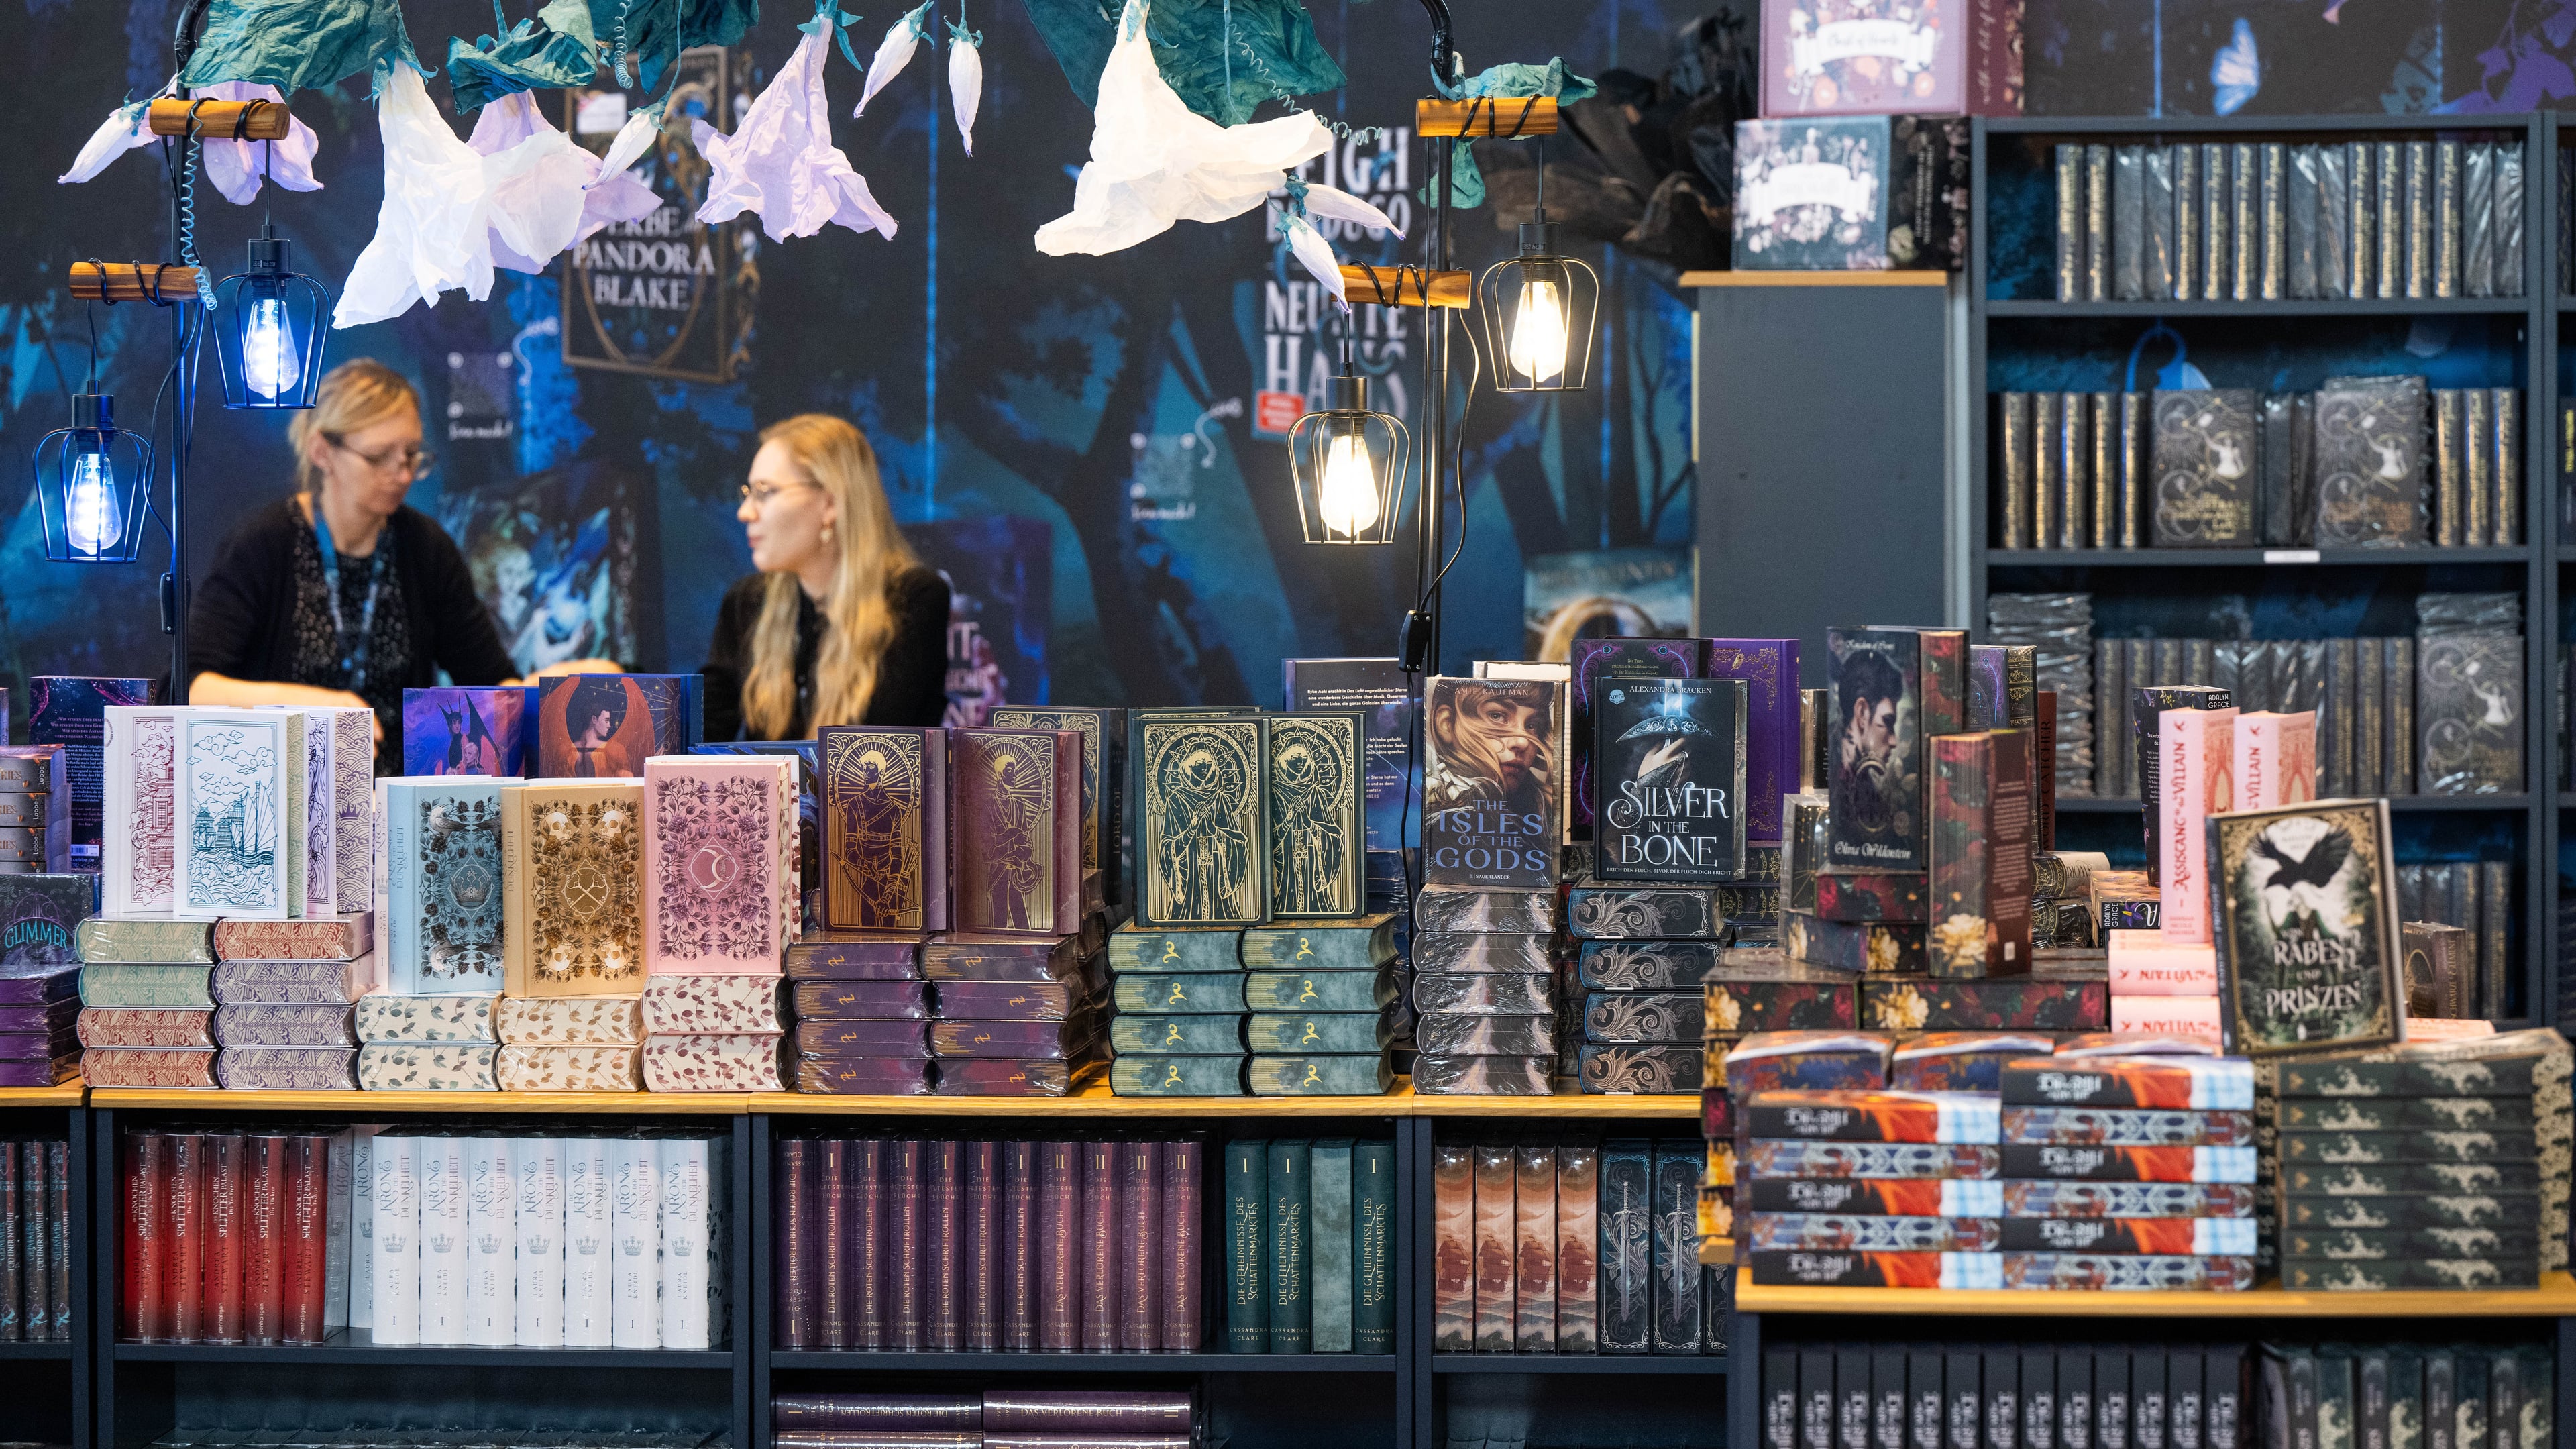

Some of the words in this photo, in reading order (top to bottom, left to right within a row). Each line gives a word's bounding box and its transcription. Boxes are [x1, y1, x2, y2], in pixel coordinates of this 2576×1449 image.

[1268, 127, 1409, 196] IGH
[572, 239, 715, 276] PANDORA
[594, 274, 690, 309] BLAKE
[2208, 694, 2229, 702] ADALYN
[2208, 700, 2230, 709] GRACE
[2041, 720, 2051, 794] CATCHER
[1472, 800, 1509, 812] THE
[1608, 780, 1729, 829] SILVER
[1440, 811, 1543, 836] ISLES
[1648, 820, 1661, 833] IN
[1664, 821, 1690, 833] THE
[1458, 835, 1481, 846] OF
[1487, 836, 1523, 847] THE
[1621, 835, 1717, 867] BONE
[1435, 847, 1546, 871] GODS
[5, 920, 68, 951] GLIMMER
[2266, 980, 2361, 1017] PRINZEN
[401, 1155, 414, 1218] DUNKELHEIT
[497, 1157, 510, 1219] DUNKELHEIT
[639, 1158, 653, 1221] DUNKELHEIT
[689, 1159, 702, 1222] DUNKELHEIT
[1236, 1197, 1244, 1215] DES
[1364, 1197, 1372, 1216] DES
[1056, 1210, 1067, 1238] BUCH
[1177, 1211, 1189, 1240] BUCH
[1236, 1212, 1249, 1286] GEHEIMNISSE
[1248, 1202, 1260, 1299] SCHATTENMARKTES
[1279, 1212, 1291, 1286] GEHEIMNISSE
[1289, 1203, 1303, 1300] SCHATTENMARKTES
[1364, 1213, 1376, 1287] GEHEIMNISSE
[1374, 1203, 1387, 1301] SCHATTENMARKTES
[1056, 1240, 1065, 1293] VERLORENE
[1177, 1240, 1185, 1293] VERLORENE
[1056, 1294, 1067, 1312] DAS
[1177, 1294, 1188, 1313] DAS
[1238, 1288, 1246, 1305] DIE
[1279, 1288, 1287, 1305] DIE
[1364, 1289, 1373, 1306] DIE
